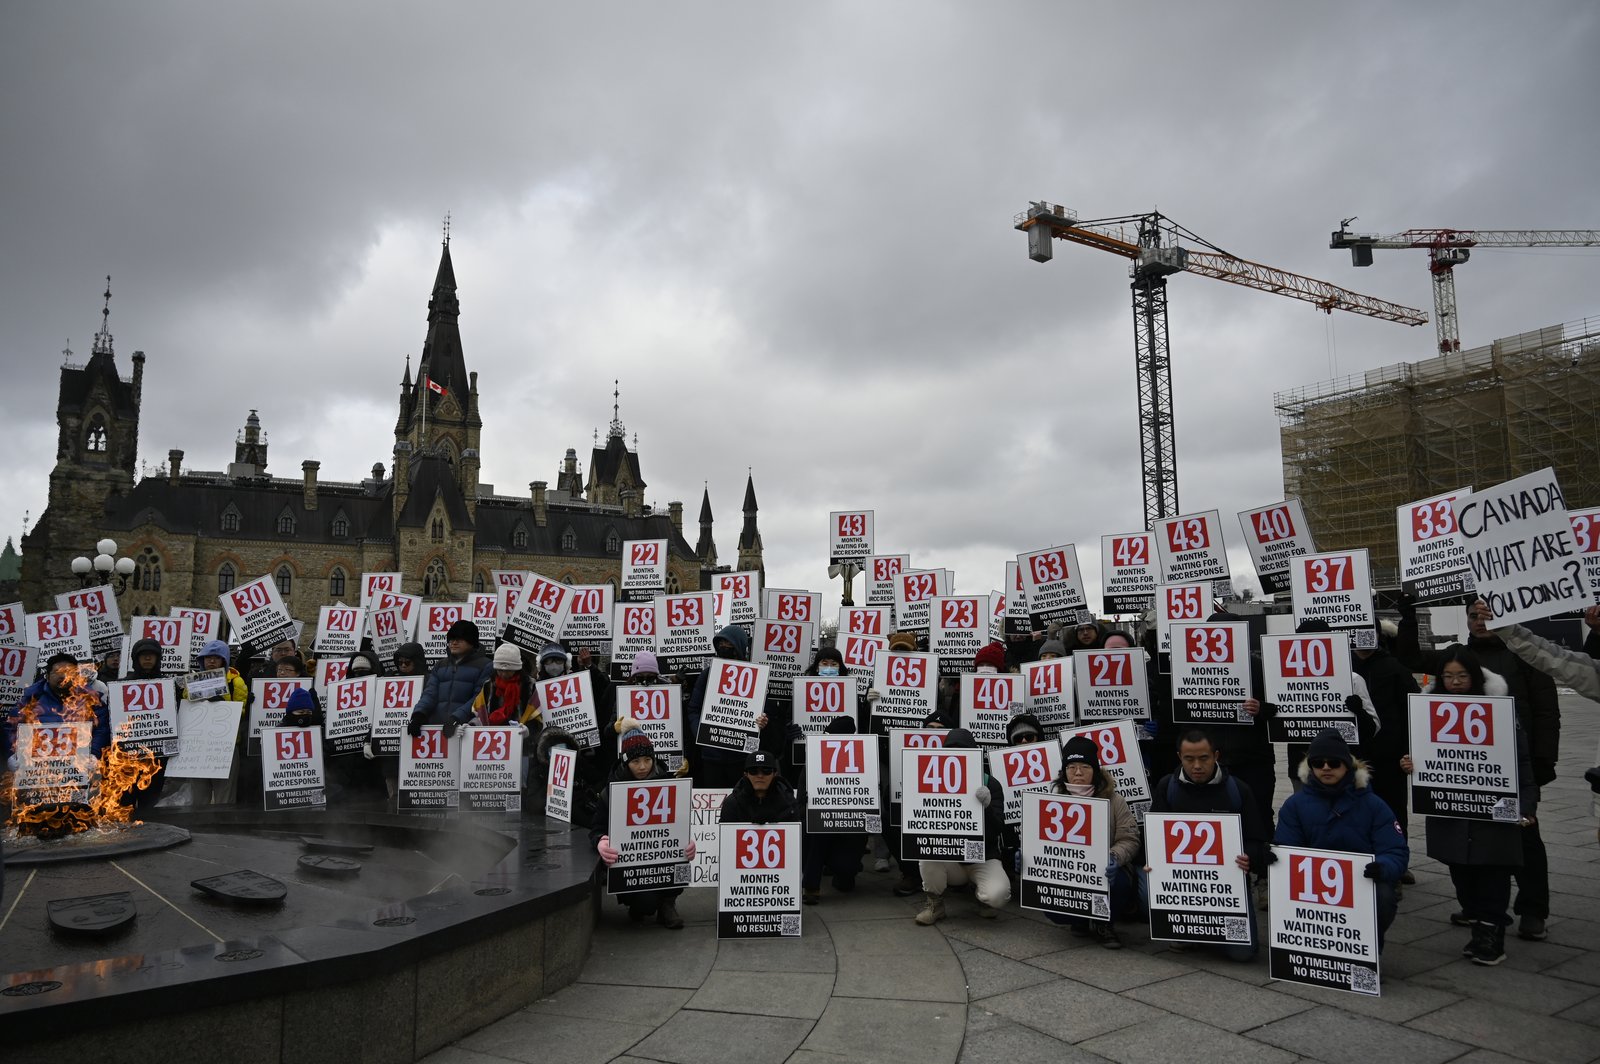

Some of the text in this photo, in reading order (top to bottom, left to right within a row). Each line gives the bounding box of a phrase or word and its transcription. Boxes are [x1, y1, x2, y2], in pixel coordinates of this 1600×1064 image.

[1416, 501, 1453, 540] 33
[1458, 482, 1566, 538] CANADA
[841, 516, 862, 536] 43
[1173, 519, 1204, 550] 43
[1259, 509, 1289, 540] 40
[634, 544, 655, 565] 22
[1117, 538, 1145, 565] 42
[1176, 551, 1208, 562] MONTHS
[1468, 530, 1573, 582] WHAT ARE
[1035, 553, 1063, 582] 63
[1167, 566, 1224, 581] IRCC RESPONSE
[1170, 558, 1218, 572] WAITING FOR
[1311, 558, 1346, 592] 37
[236, 585, 266, 613] 30
[532, 582, 560, 610] 13
[907, 574, 933, 601] 32
[1479, 560, 1587, 618] YOU DOING?
[574, 589, 602, 614] 70
[671, 599, 699, 626] 53
[781, 596, 807, 621] 35
[1171, 588, 1198, 618] 55
[42, 614, 73, 639] 30
[241, 611, 281, 632] WAITING FOR
[241, 615, 287, 640] IRCC RESPONSE
[245, 608, 271, 623] MONTHS
[328, 611, 353, 631] 20
[378, 612, 395, 636] 32
[623, 608, 653, 635] 68
[853, 610, 878, 633] 37
[942, 601, 977, 629] 23
[768, 625, 797, 652] 28
[1191, 629, 1228, 662] 33
[1093, 655, 1125, 685] 27
[1286, 640, 1327, 676] 40
[722, 666, 753, 697] 30
[891, 657, 921, 687] 65
[1034, 665, 1058, 694] 41
[1182, 677, 1240, 686] WAITING FOR
[1191, 667, 1229, 675] MONTHS
[127, 684, 164, 711] 20
[340, 682, 363, 709] 55
[386, 681, 410, 708] 34
[549, 679, 578, 707] 34
[719, 698, 748, 709] MONTHS
[810, 682, 840, 712] 90
[977, 678, 1008, 710] 40
[1178, 687, 1245, 696] IRCC RESPONSE
[635, 691, 665, 720] 30
[711, 705, 754, 719] WAITING FOR
[1198, 702, 1238, 710] TIMELINES
[705, 713, 756, 728] IRCC RESPONSE
[1436, 703, 1487, 744] 26
[280, 732, 308, 760] 51
[416, 731, 444, 758] 31
[476, 732, 506, 760] 23
[826, 740, 859, 773] 71
[1437, 748, 1487, 761] MONTHS
[554, 756, 568, 787] 42
[923, 756, 962, 793] 40
[1009, 750, 1045, 785] 28
[1425, 760, 1501, 774] WAITING FOR
[817, 787, 869, 795] WAITING FOR
[826, 777, 860, 786] MONTHS
[1419, 772, 1509, 788] IRCC RESPONSE
[632, 787, 671, 825] 34
[812, 797, 874, 806] IRCC RESPONSE
[923, 798, 962, 808] MONTHS
[1431, 790, 1499, 804] NO TIMELINES
[1435, 801, 1493, 814] NO RESULTS
[908, 820, 978, 831] IRCC RESPONSE
[913, 809, 972, 819] WAITING FOR
[1044, 802, 1086, 844] 32
[620, 839, 679, 852] WAITING FOR
[631, 828, 669, 840] MONTHS
[1171, 821, 1217, 864] 22
[636, 849, 683, 861] RESPONSE
[741, 829, 780, 869] 36
[1044, 846, 1085, 860] MONTHS
[1028, 867, 1102, 886] IRCC RESPONSE
[1033, 856, 1096, 873] WAITING FOR
[1172, 869, 1219, 881] MONTHS
[730, 885, 790, 895] WAITING FOR
[740, 874, 779, 883] MONTHS
[1161, 882, 1232, 894] WAITING FOR
[1298, 857, 1344, 905] 19
[724, 897, 795, 907] IRCC RESPONSE
[1037, 885, 1093, 901] NO TIMELINES
[1040, 895, 1088, 910] NO RESULTS
[1156, 894, 1239, 908] IRCC RESPONSE
[1296, 908, 1346, 924] MONTHS
[1284, 920, 1361, 940] WAITING FOR
[1277, 932, 1369, 956] IRCC RESPONSE
